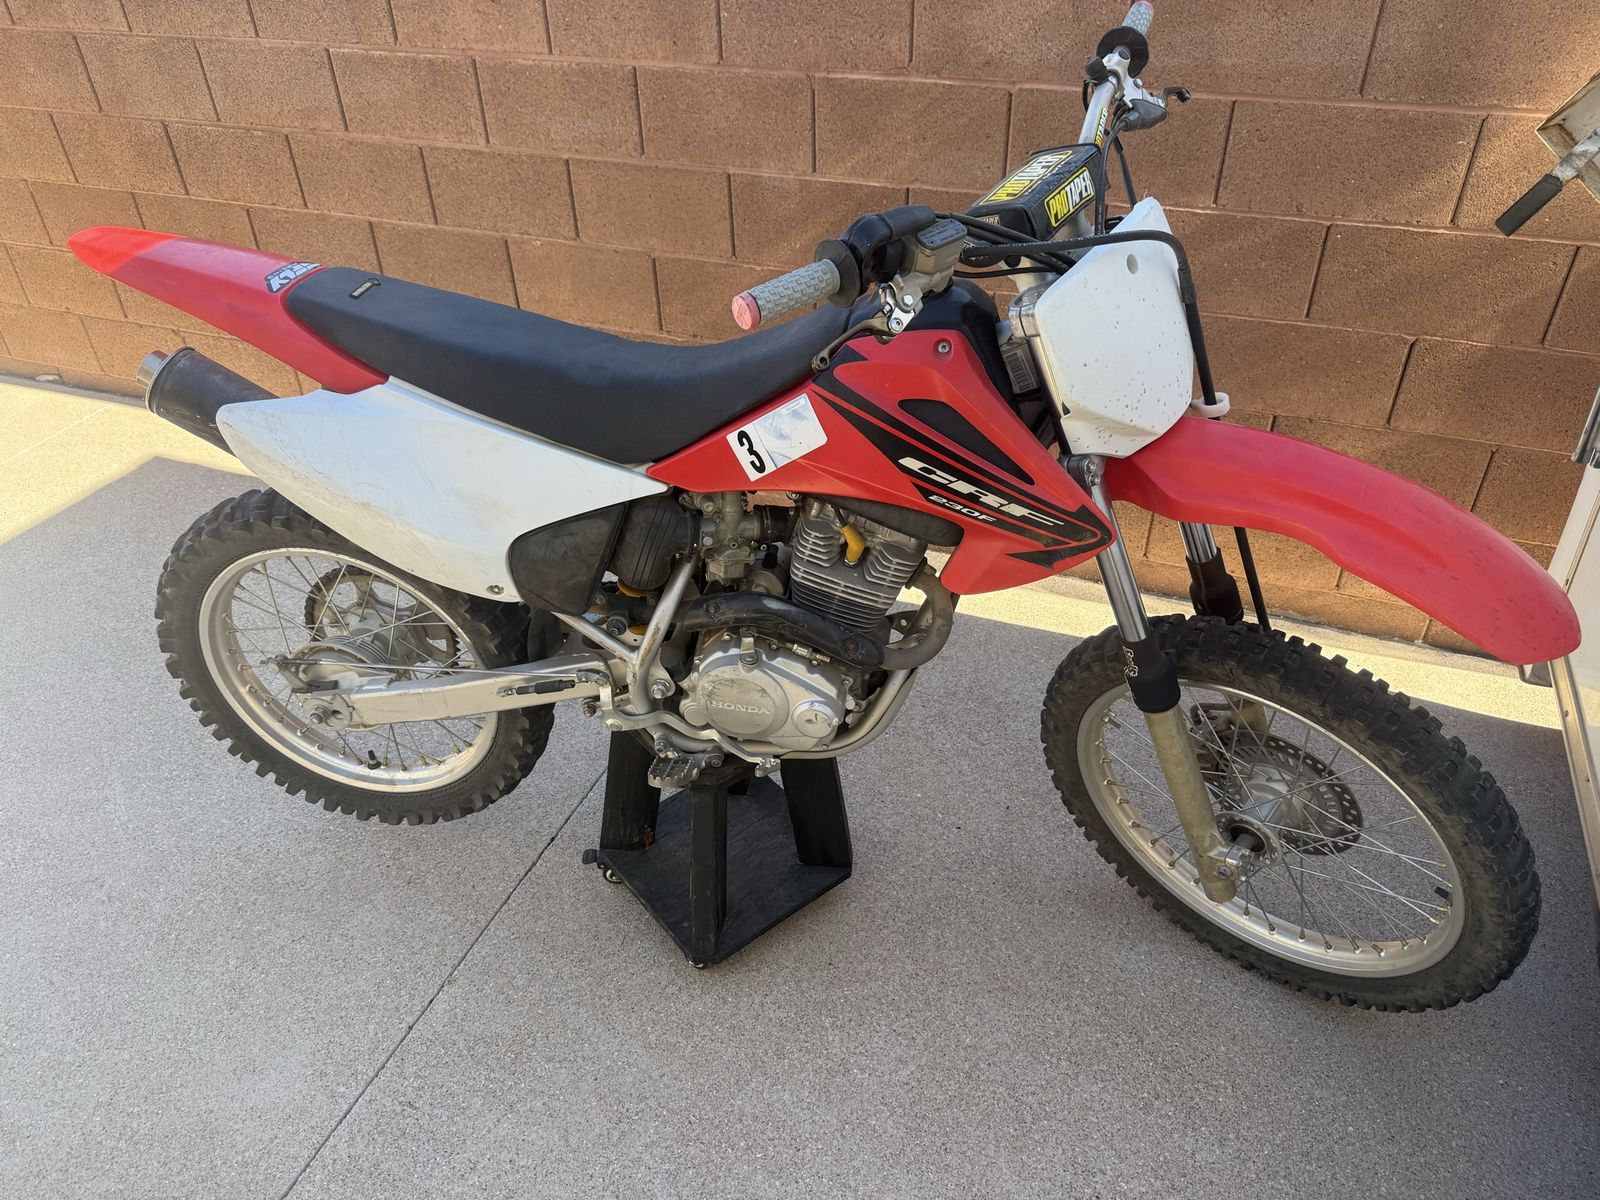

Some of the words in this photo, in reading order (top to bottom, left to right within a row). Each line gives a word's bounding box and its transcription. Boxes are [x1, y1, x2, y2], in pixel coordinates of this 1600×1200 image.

[1048, 171, 1095, 225] PROTAPER
[737, 430, 767, 474] 3
[898, 456, 1065, 526] CRF
[928, 495, 997, 523] 230F
[711, 700, 772, 715] HONDA
